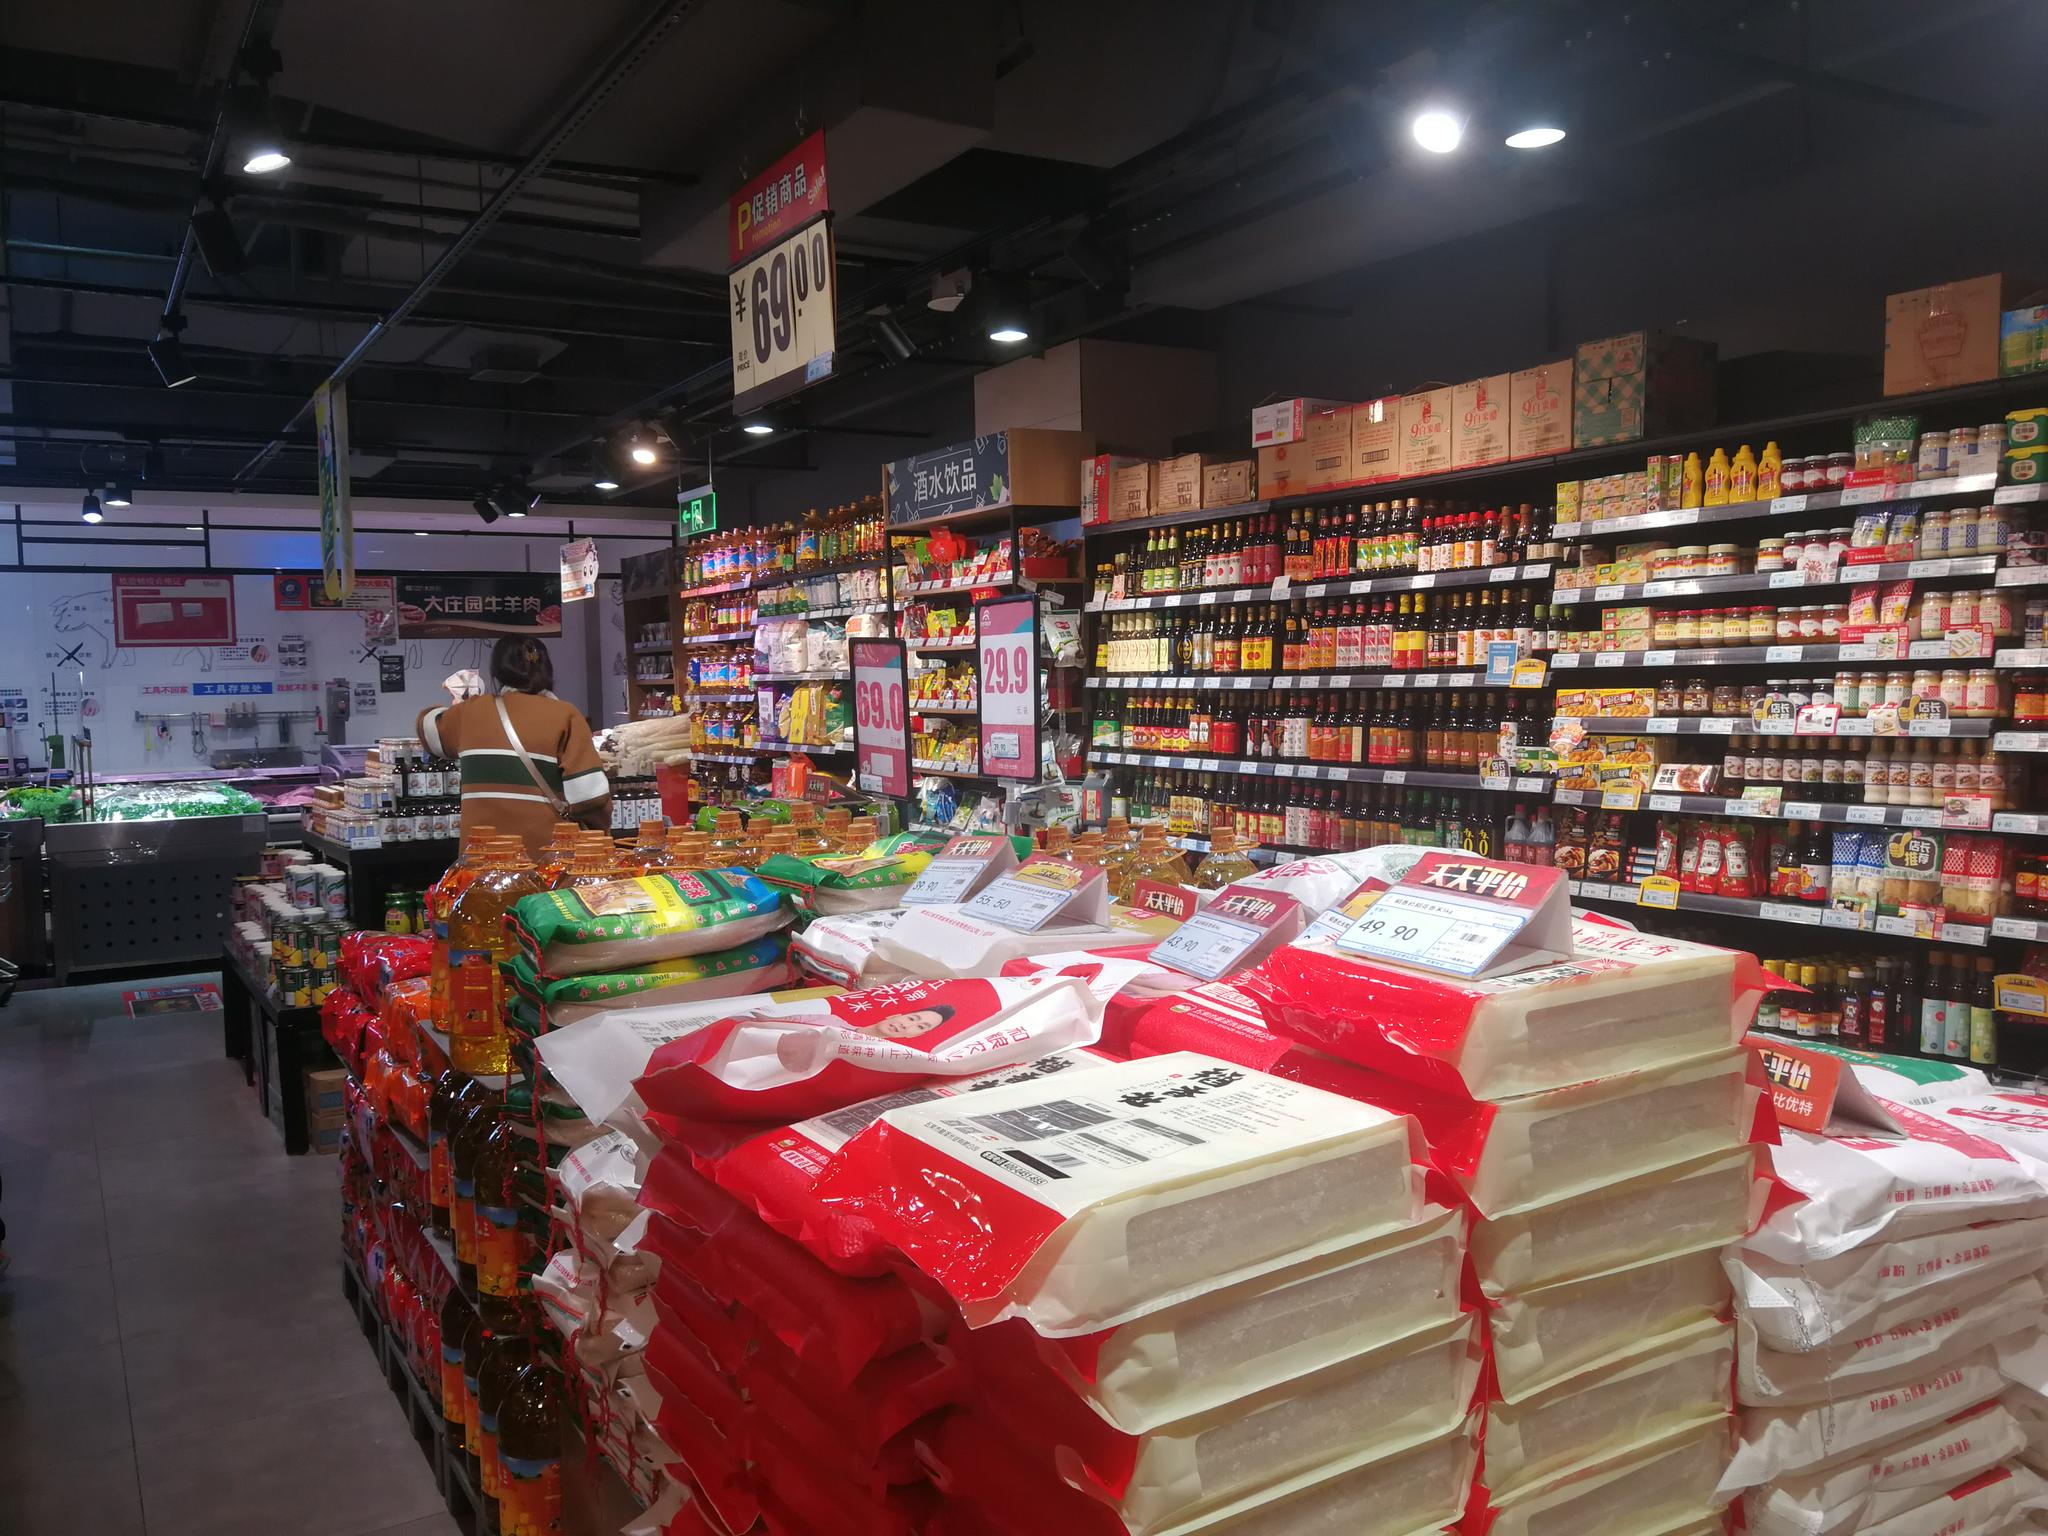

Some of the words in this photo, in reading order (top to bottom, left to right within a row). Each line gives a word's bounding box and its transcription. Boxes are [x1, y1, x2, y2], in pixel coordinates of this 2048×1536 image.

[751, 163, 807, 226] 促销商品
[913, 457, 977, 502] 酒水饮品
[424, 595, 542, 613] 大庄园牛羊肉
[984, 646, 1028, 694] 29.9
[205, 684, 264, 694] 工具存放处
[857, 680, 904, 731] 69.0
[1904, 851, 1929, 866] 推荐
[1909, 840, 1930, 853] 店长
[911, 880, 939, 893] 39.90
[1420, 862, 1530, 901] 天天平价
[975, 894, 1012, 911] 55.50
[1145, 890, 1185, 918] 天天平价
[1216, 894, 1278, 922] 天天平价
[1357, 918, 1419, 943] 49.90
[1166, 935, 1199, 953] 43.90
[1772, 1091, 1813, 1117] 比优特
